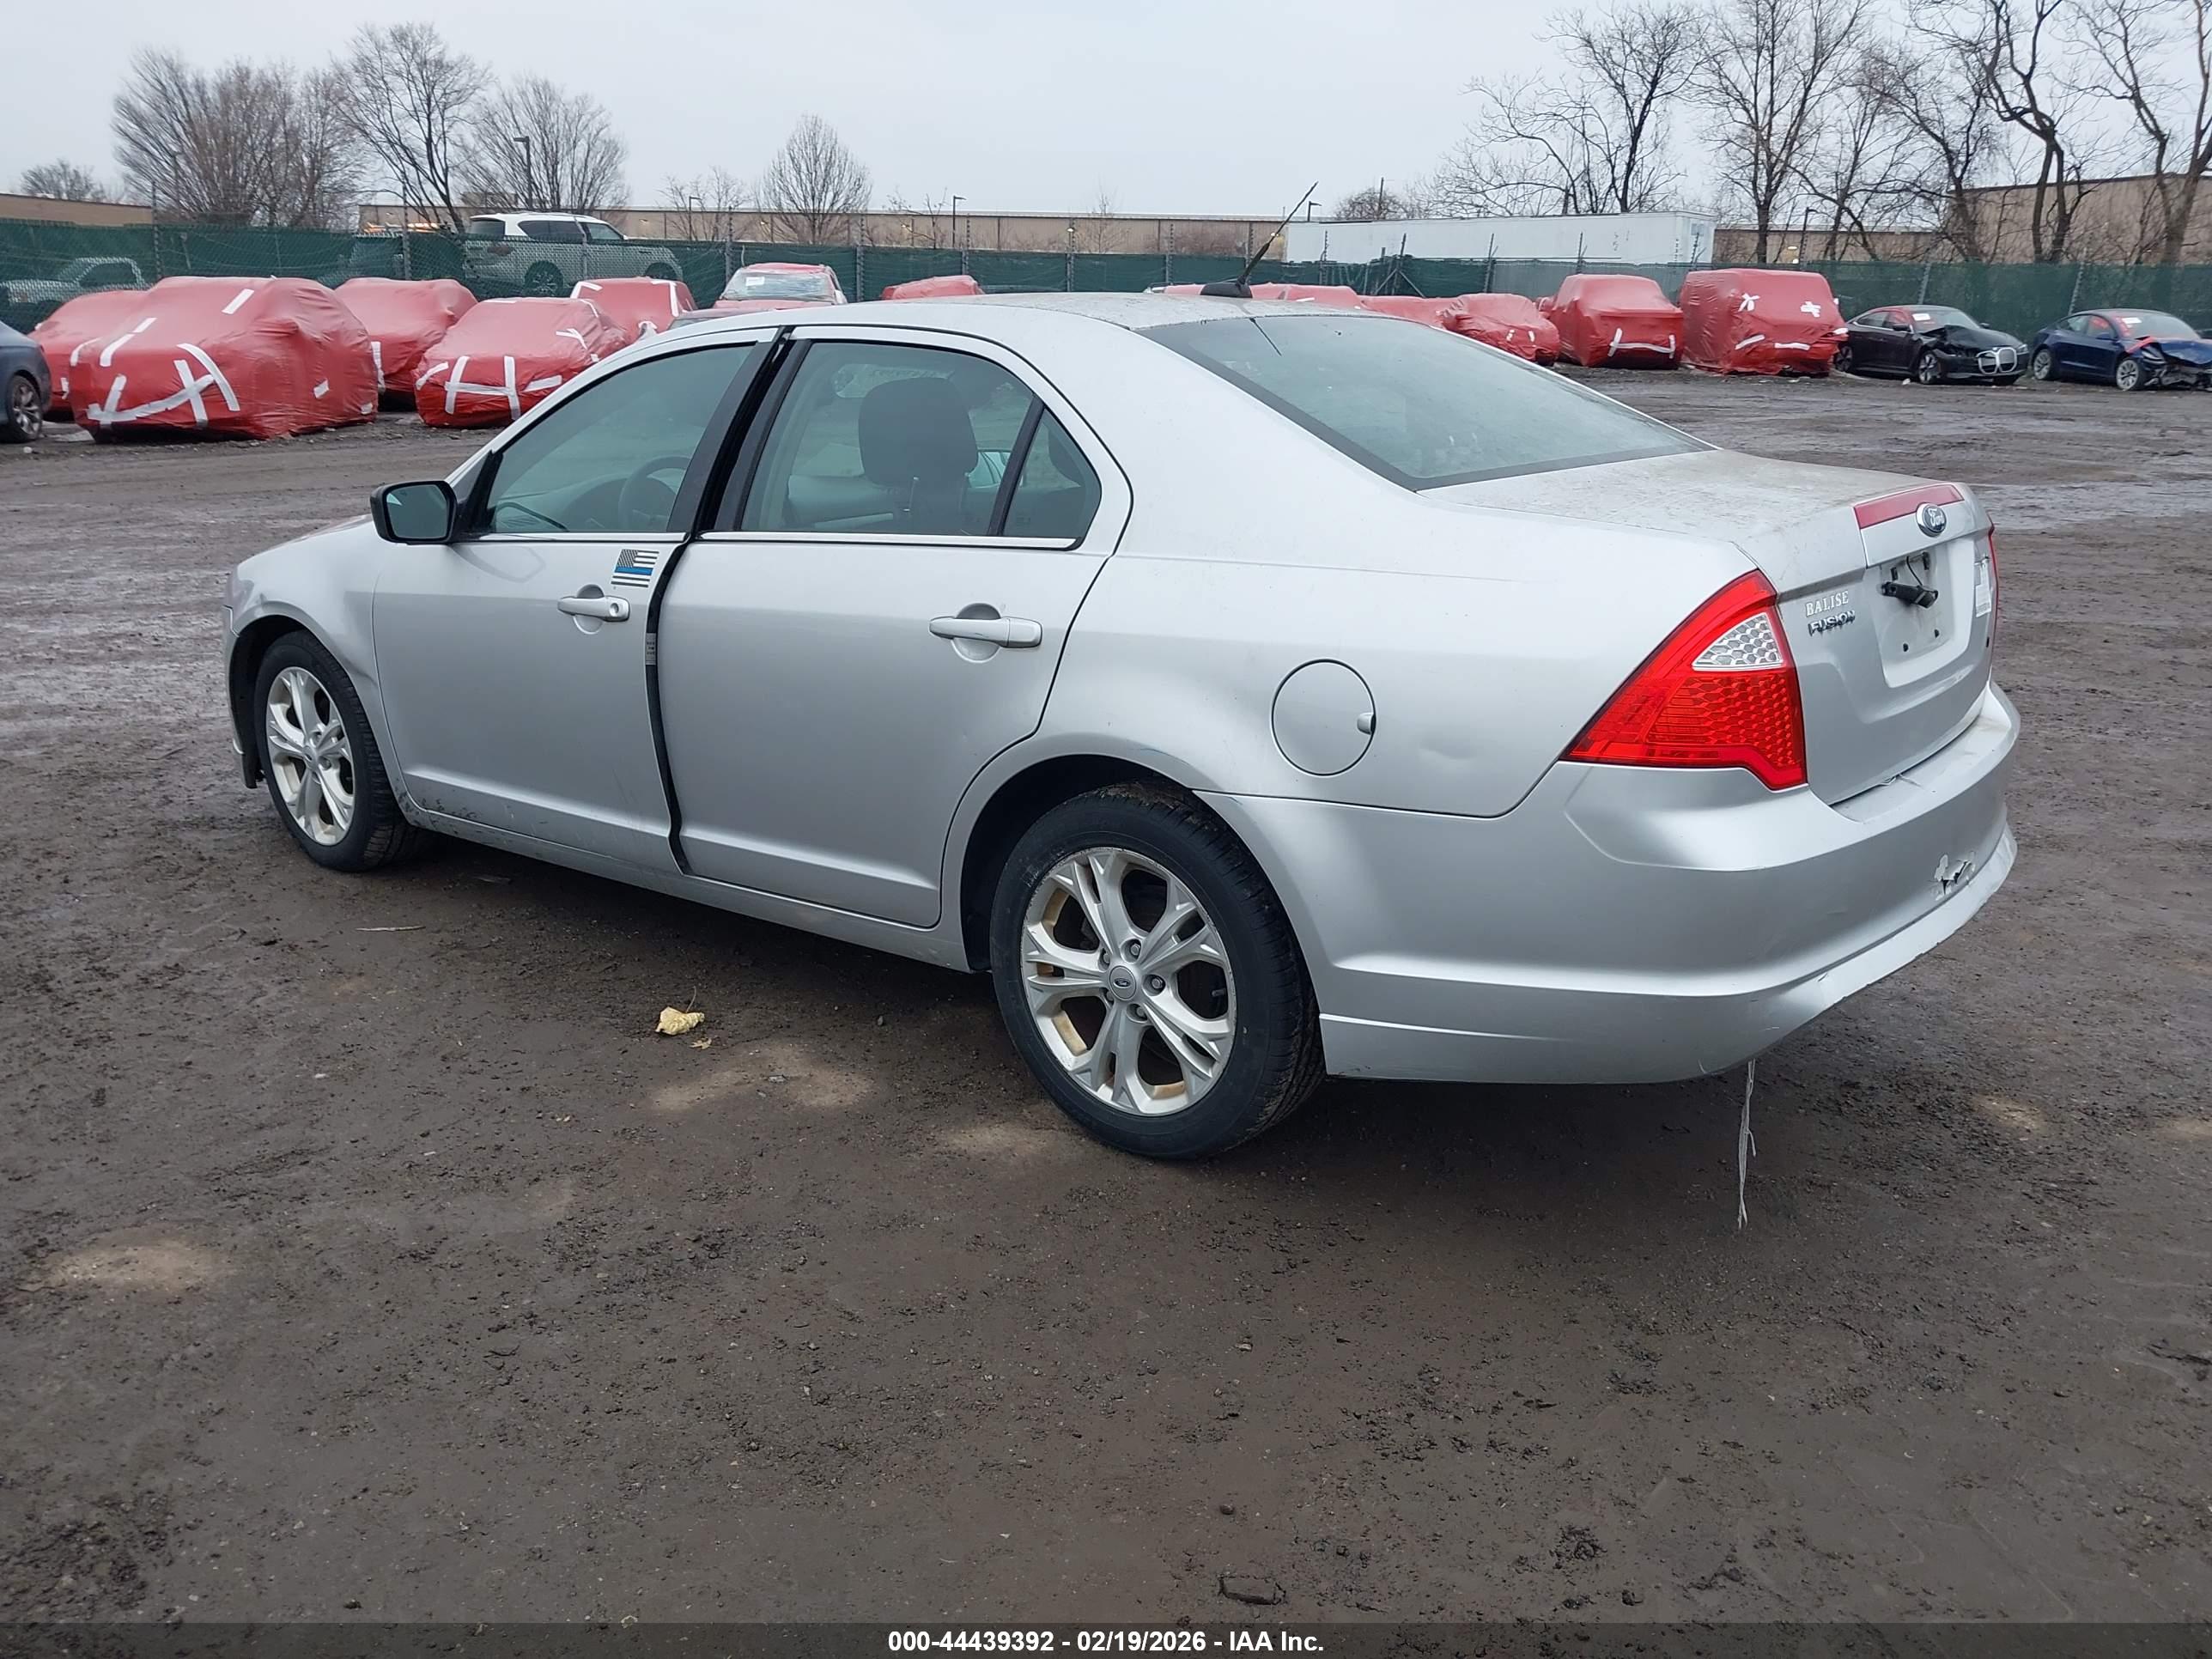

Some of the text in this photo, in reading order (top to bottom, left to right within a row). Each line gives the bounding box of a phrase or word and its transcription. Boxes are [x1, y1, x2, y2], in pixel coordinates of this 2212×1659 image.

[1927, 507, 1946, 527] Ford
[1805, 590, 1849, 617] BALISE
[1809, 610, 1856, 632] FUSION
